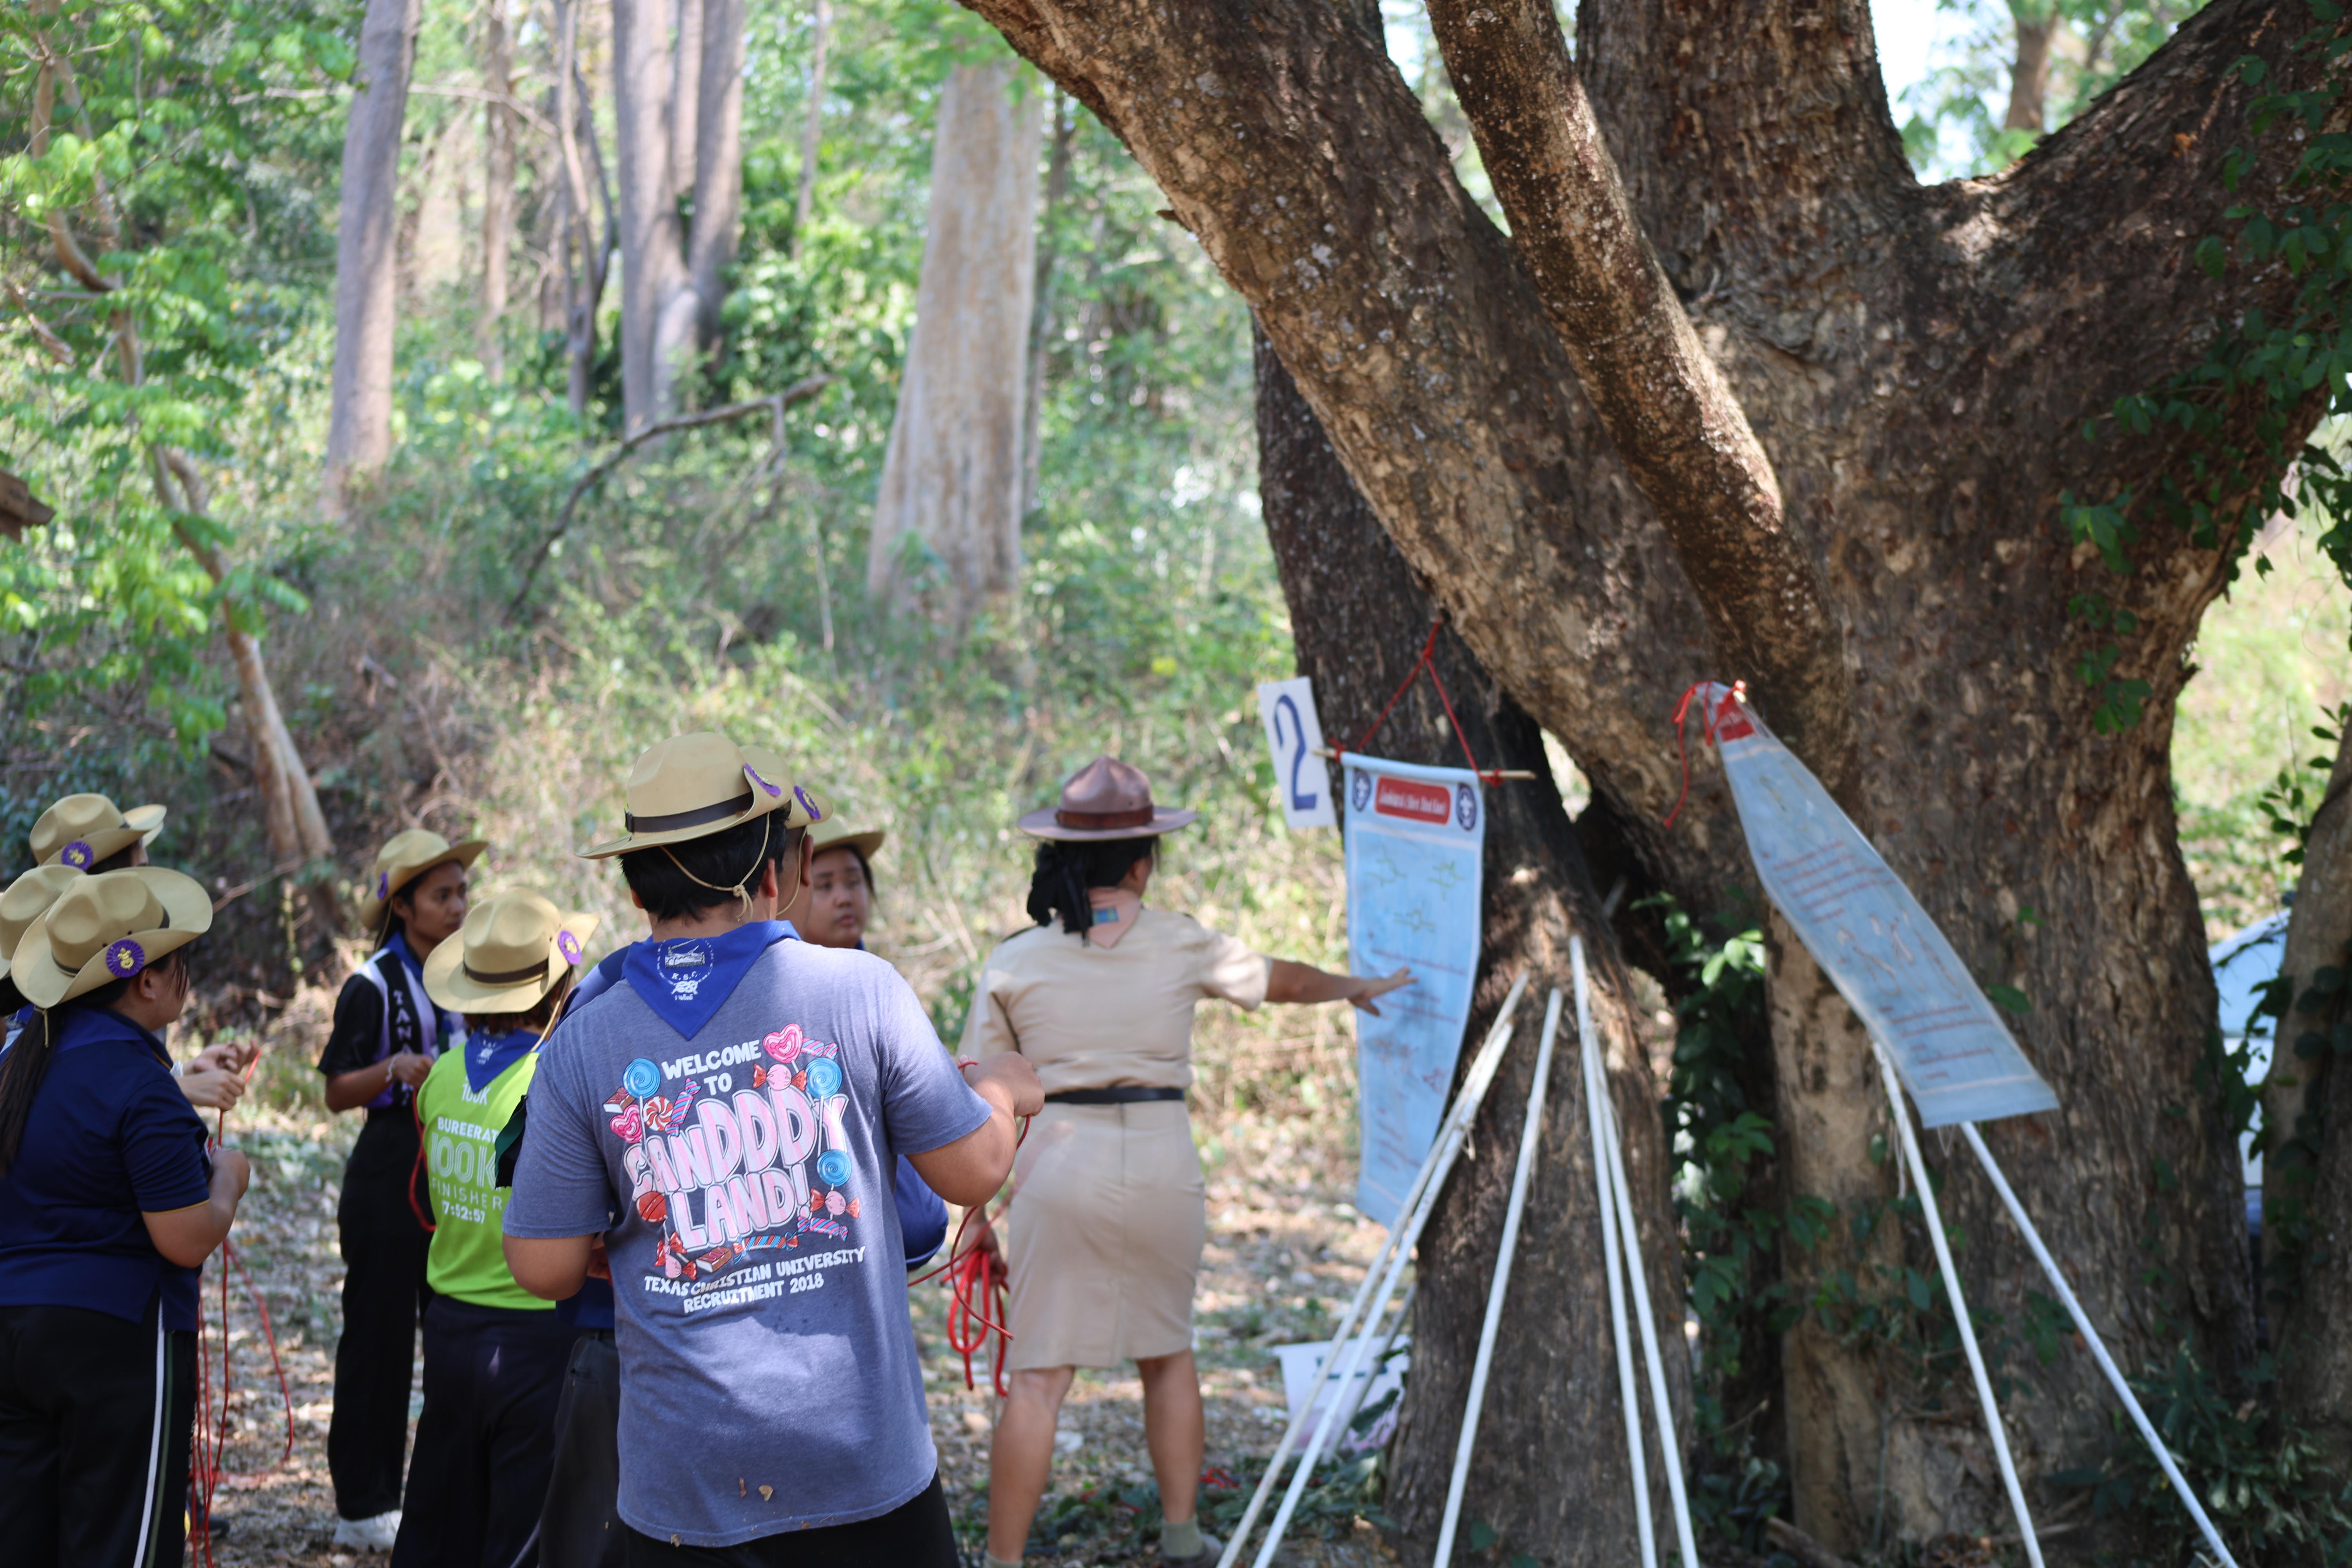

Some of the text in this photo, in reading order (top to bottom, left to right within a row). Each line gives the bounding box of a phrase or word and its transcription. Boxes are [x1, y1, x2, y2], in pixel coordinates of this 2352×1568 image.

[1274, 695, 1317, 810] 2
[661, 1040, 762, 1080] WELCOME
[704, 1073, 732, 1096] TO
[431, 1132, 502, 1192] 100K
[432, 1177, 502, 1210] FINISHER
[670, 1163, 812, 1252] LAND!
[644, 1246, 866, 1296] TEXAS CHRISTIAN UNIVERSITY
[683, 1272, 824, 1314] RECRUITMENT 2018
